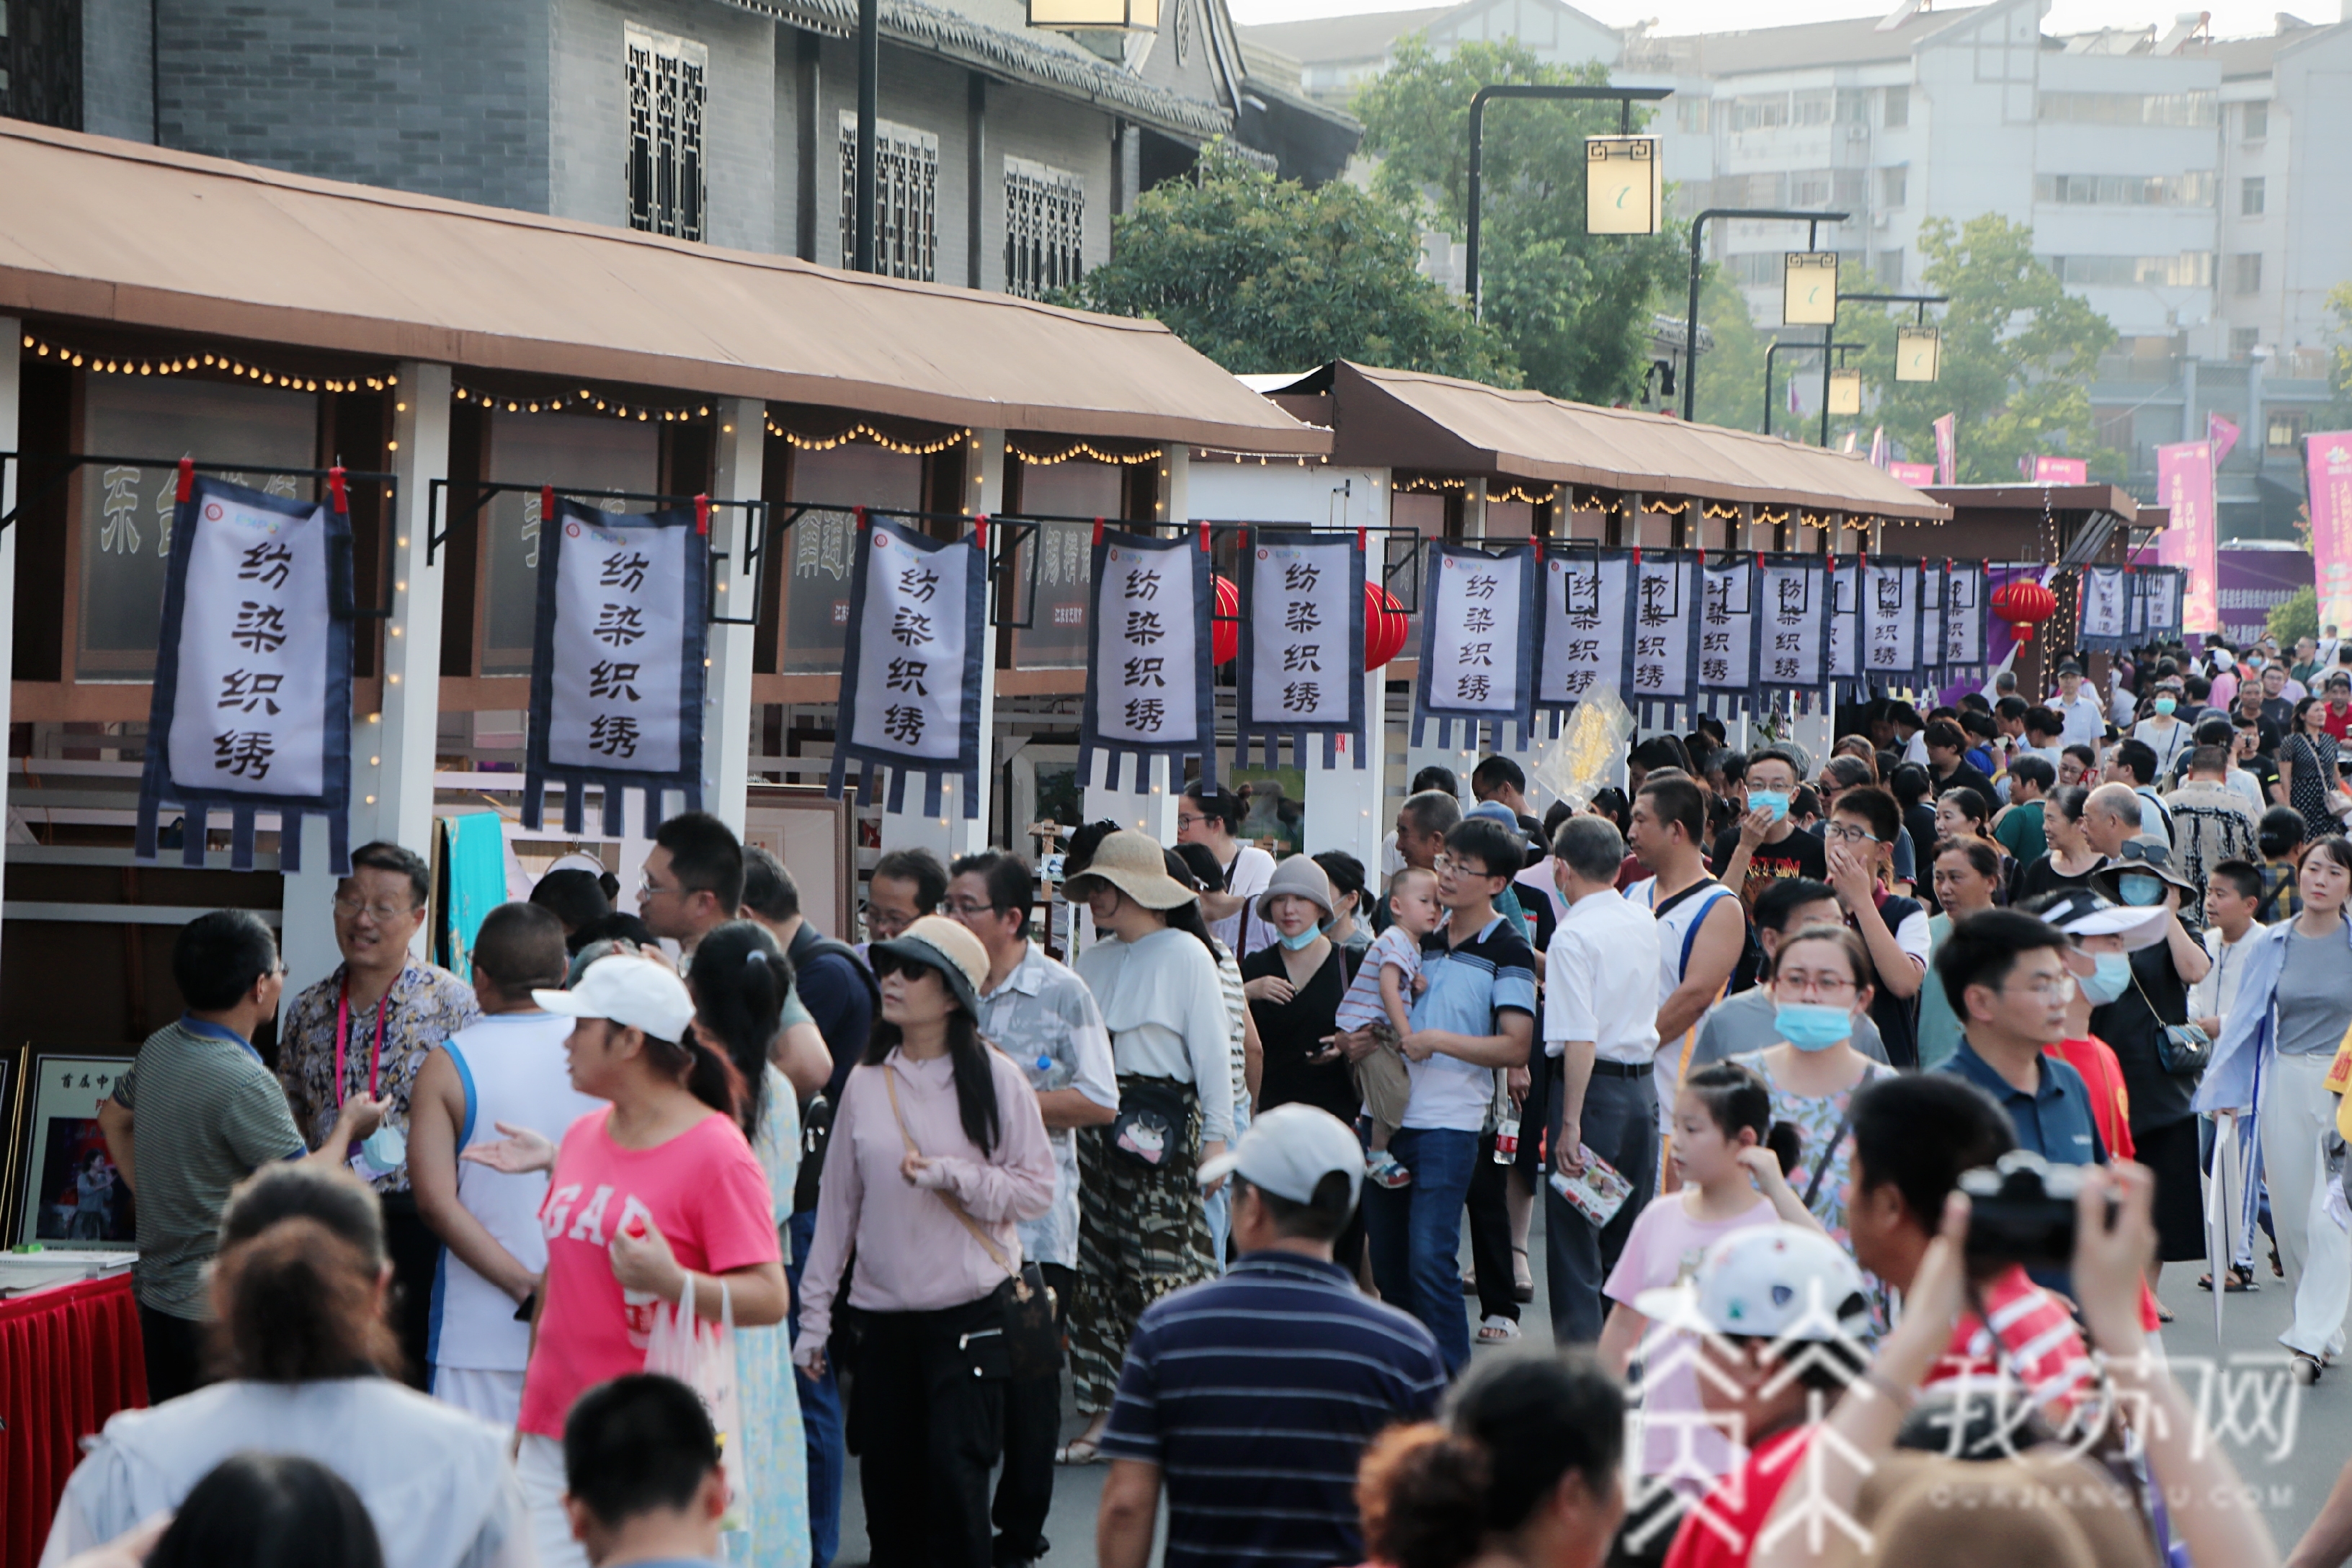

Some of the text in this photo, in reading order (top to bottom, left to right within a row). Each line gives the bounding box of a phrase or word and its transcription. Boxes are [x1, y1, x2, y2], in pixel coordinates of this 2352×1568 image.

[213, 541, 293, 780] 纺染织绣
[589, 551, 649, 758] 纺染织绣
[883, 569, 939, 746] 纺染织绣
[1123, 569, 1166, 732] 纺染织绣
[1283, 563, 1322, 713] 纺染织绣
[1457, 575, 1498, 702] 纺染织绣
[1567, 575, 1603, 694] 纺染织绣
[1636, 575, 1669, 689] 纺染织绣
[1775, 579, 1803, 678] 纺染织绣
[61, 1072, 110, 1090] 首届中
